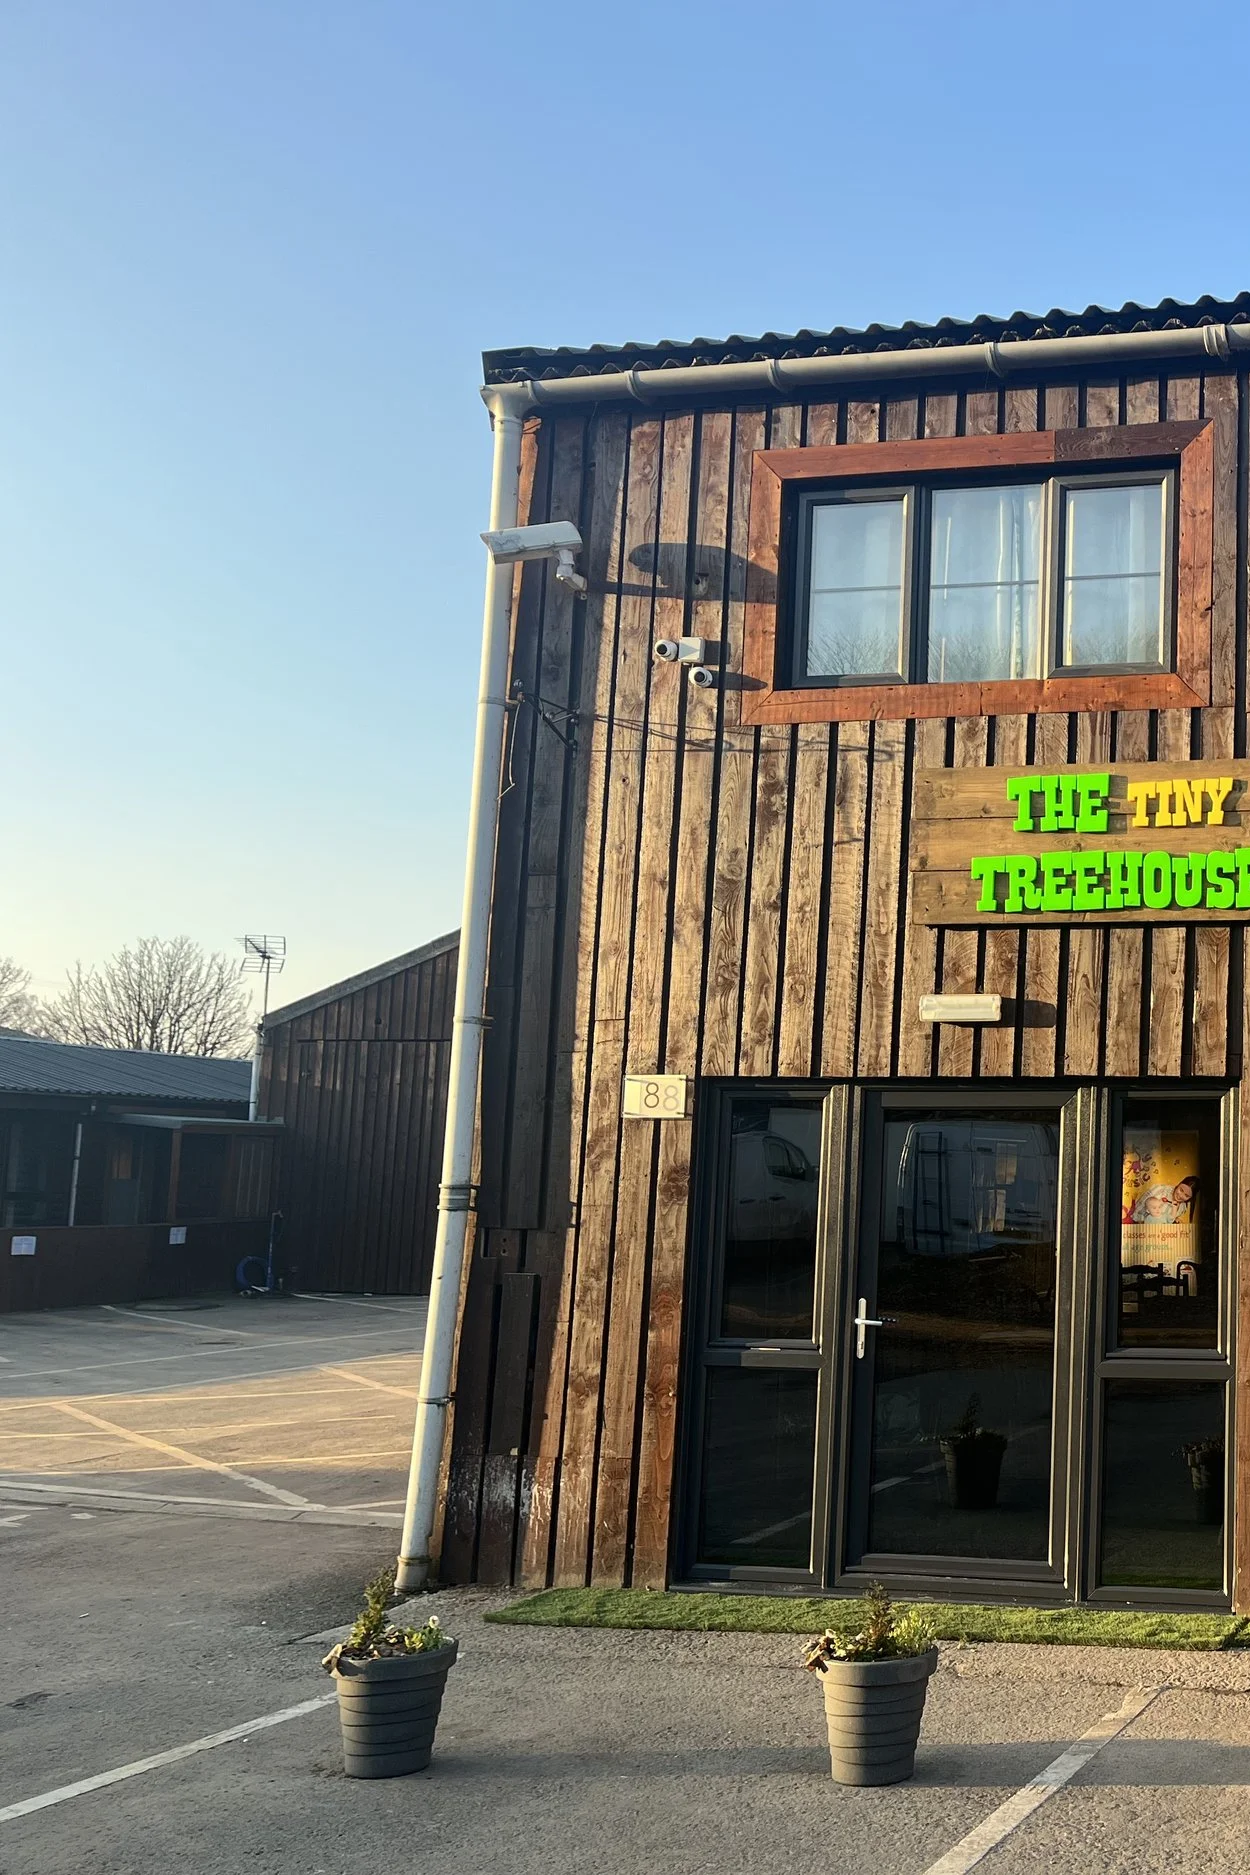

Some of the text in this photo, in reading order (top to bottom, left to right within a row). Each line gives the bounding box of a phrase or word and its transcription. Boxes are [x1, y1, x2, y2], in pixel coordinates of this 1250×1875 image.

[1007, 773, 1233, 832] THE TINY
[1123, 1173, 1151, 1188] usic
[1123, 1231, 1146, 1239] classes
